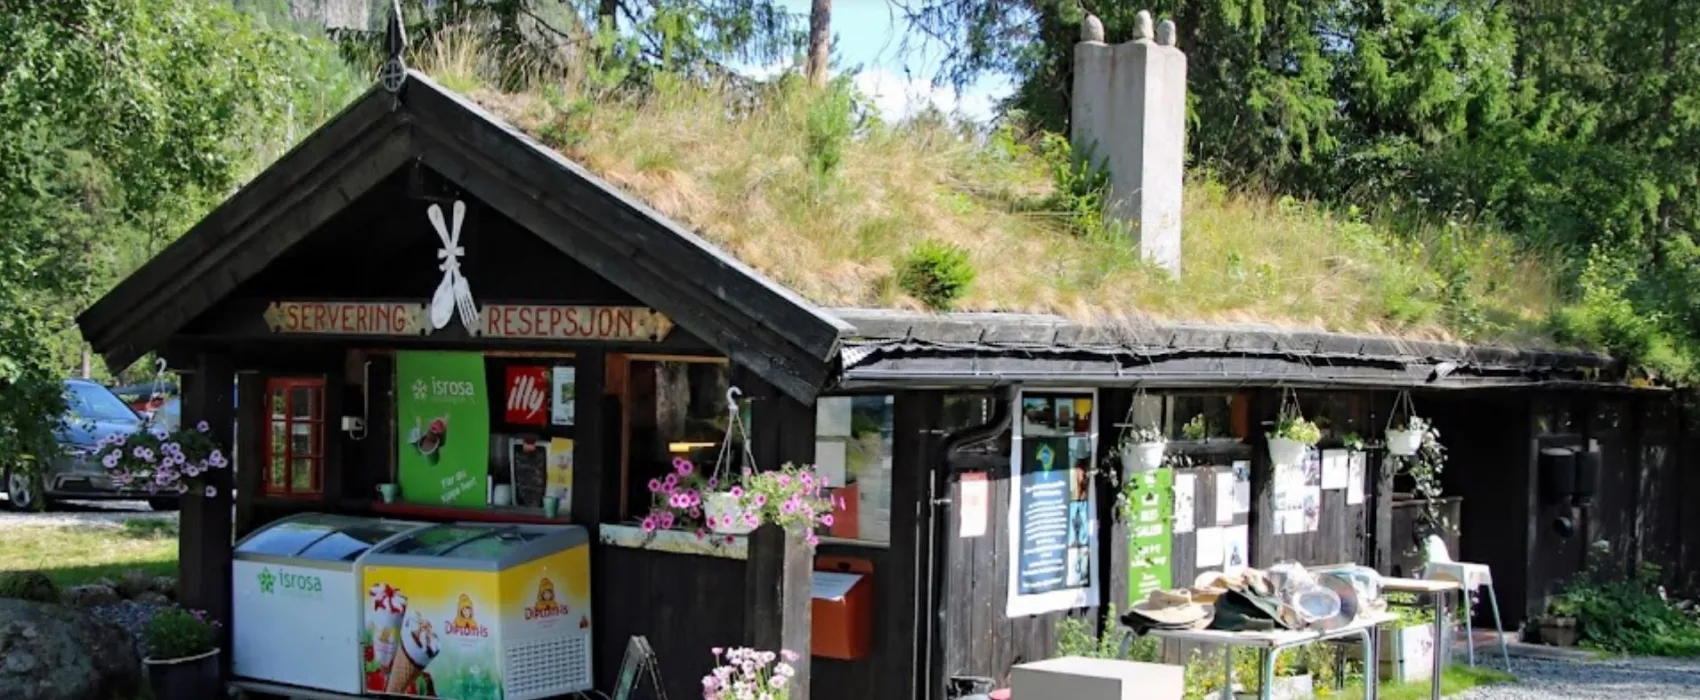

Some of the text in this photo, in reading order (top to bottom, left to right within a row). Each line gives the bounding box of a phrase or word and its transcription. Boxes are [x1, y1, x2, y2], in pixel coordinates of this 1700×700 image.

[287, 304, 406, 332] SERVERING
[488, 306, 633, 337] RESEPSJON
[432, 376, 474, 396] isrosa
[507, 374, 545, 420] illy
[279, 567, 322, 592] isrosa
